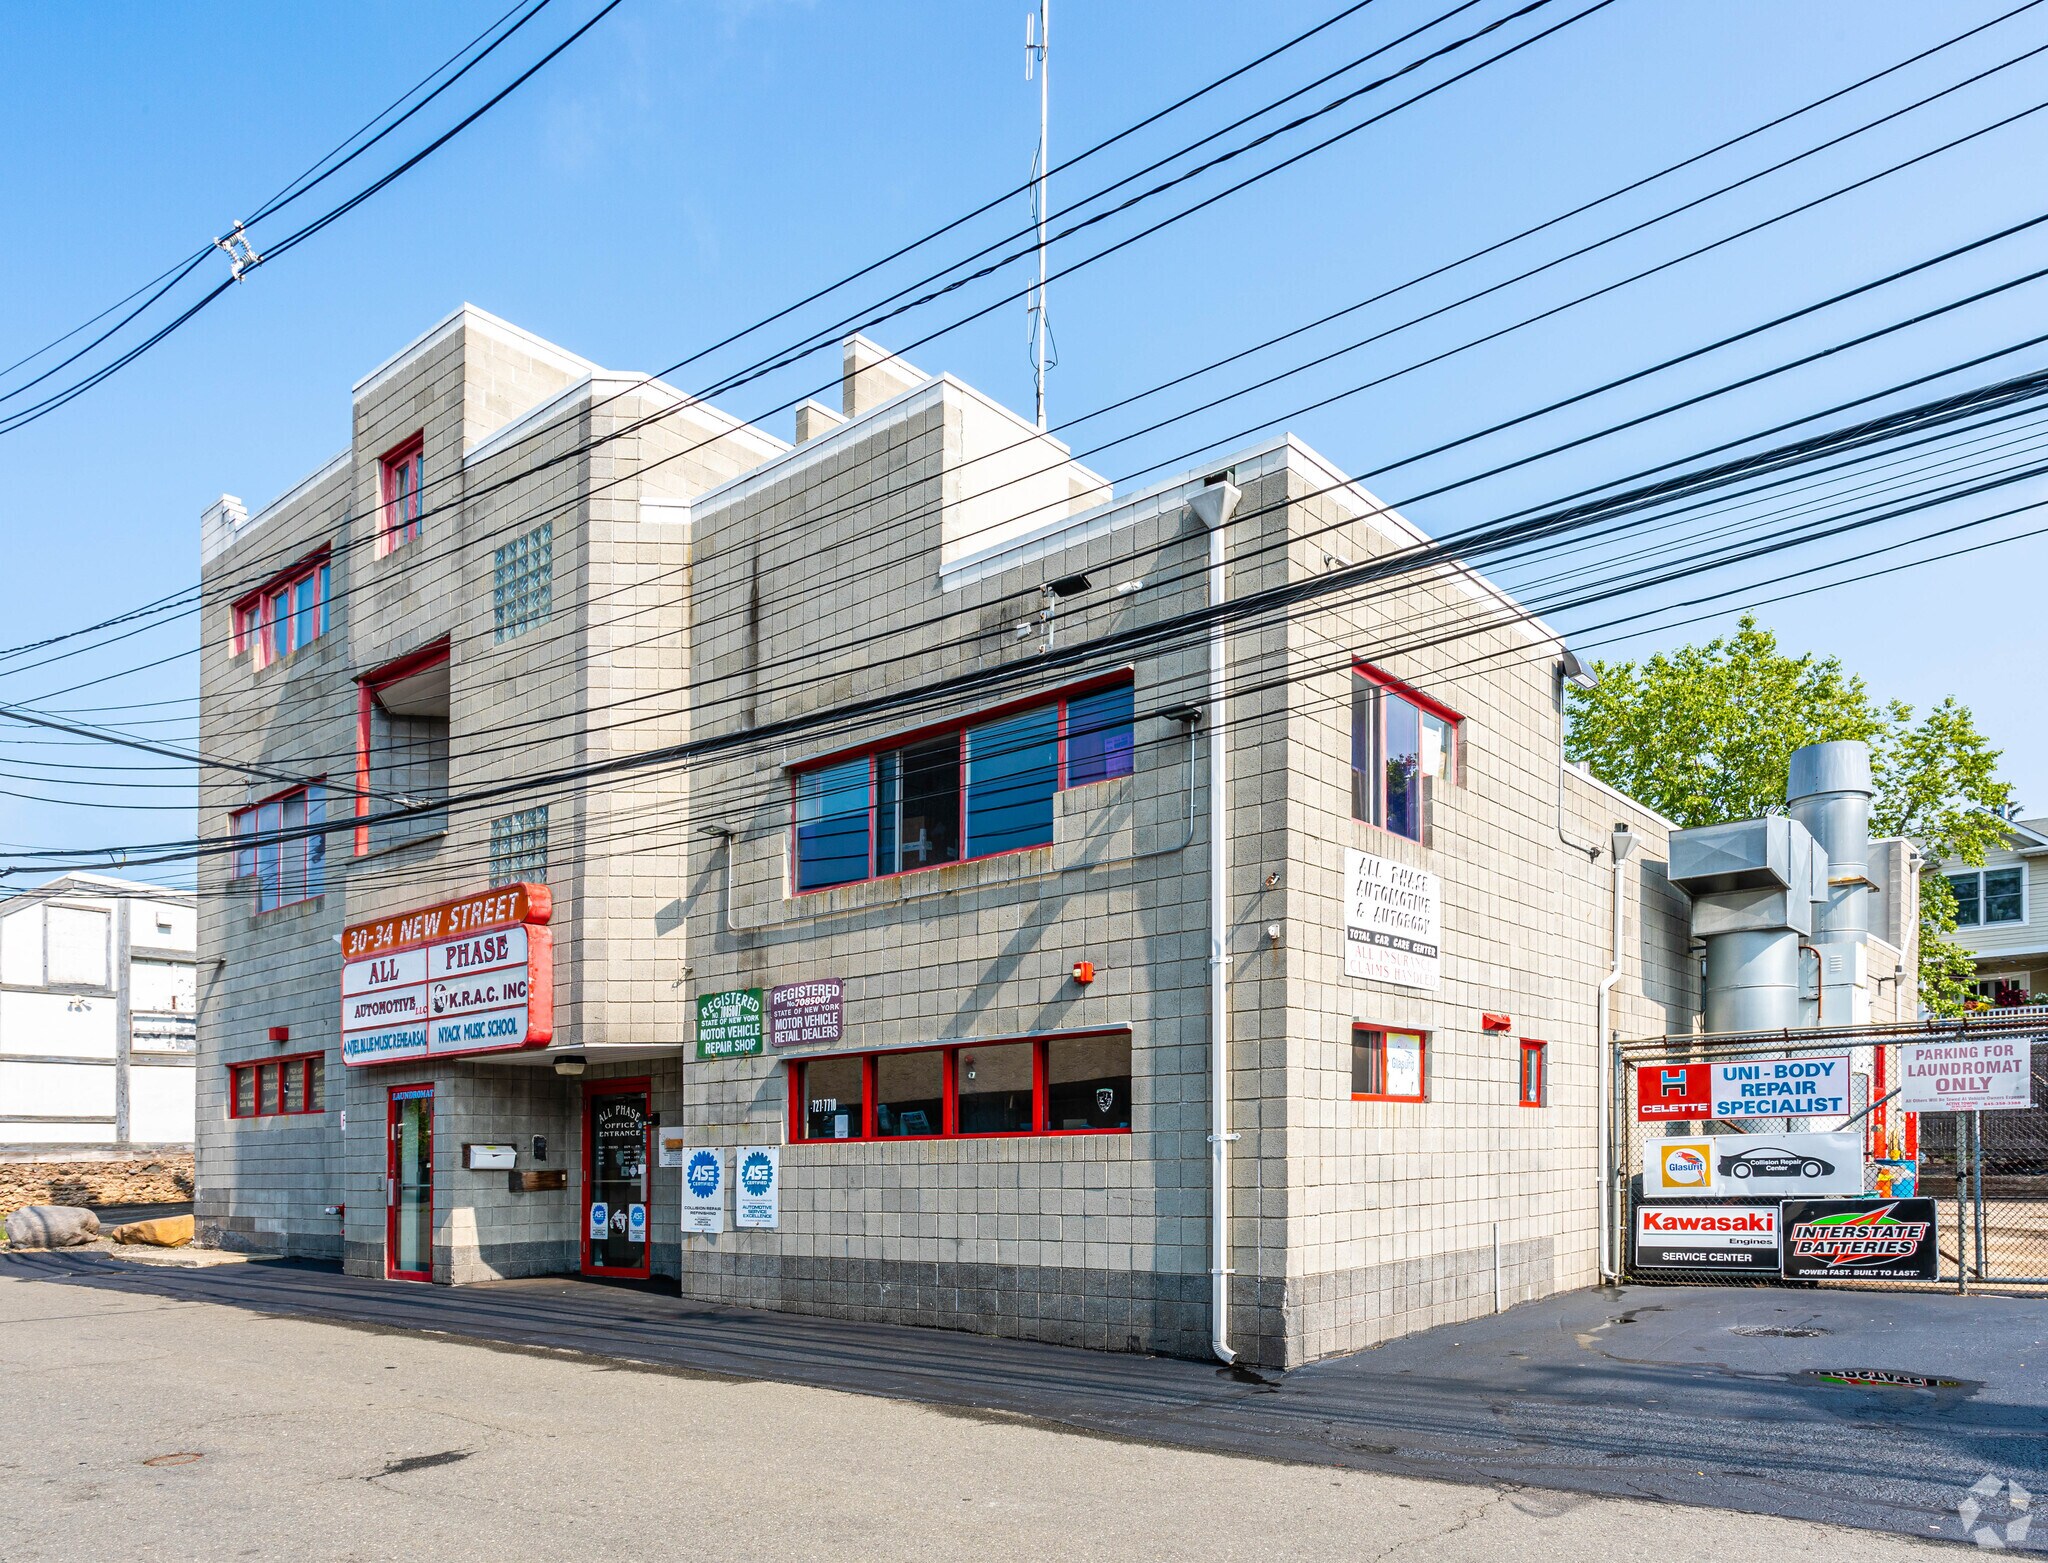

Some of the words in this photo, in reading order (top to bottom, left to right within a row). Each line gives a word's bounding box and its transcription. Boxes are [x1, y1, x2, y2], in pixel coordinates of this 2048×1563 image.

[349, 923, 394, 954] 30-34
[400, 911, 443, 943] NEW
[449, 892, 519, 932] STREET
[1349, 929, 1371, 942] TOTAL
[1374, 934, 1390, 946] CAR
[1393, 938, 1410, 951] CARE
[1412, 943, 1436, 957] CENTER
[368, 959, 400, 985] ALL
[446, 933, 509, 970] PHASE
[1355, 945, 1374, 960] ALL
[449, 988, 500, 1009] K.R.A.C.
[503, 980, 527, 1000] INC
[773, 984, 840, 1005] REGISTERED
[354, 995, 416, 1018] AUTOMOTIVE
[415, 1004, 428, 1016] LLC
[701, 992, 760, 1019] REGISTERED
[773, 1009, 792, 1017] STATE
[804, 1006, 819, 1014] NEW
[821, 1003, 840, 1011] YORK
[701, 1019, 719, 1027] STATE
[719, 1017, 727, 1025] OF
[775, 1016, 804, 1030] MOTOR
[804, 1012, 838, 1027] VEHICLE
[438, 1027, 461, 1043] NYACK
[463, 1022, 486, 1041] MUSIC
[487, 1017, 518, 1038] SCHOOL
[700, 1027, 726, 1041] MOTOR
[727, 1023, 761, 1038] VEHICLE
[774, 1029, 801, 1043] RETAIL
[802, 1026, 839, 1040] DEALERS
[705, 1041, 733, 1054] REPAIR
[734, 1038, 756, 1051] SHOP
[1915, 1046, 1979, 1060] PARKING
[1984, 1044, 2014, 1057] FOR
[1908, 1059, 2023, 1077] LAUNDROMAT
[1741, 1080, 1816, 1098] REPAIR
[1935, 1076, 1993, 1092] ONLY
[392, 1089, 434, 1101] LAUNDROMAT
[599, 1107, 612, 1124] ALL
[615, 1104, 641, 1123] PHASE
[1641, 1103, 1708, 1114] CELETTE
[1717, 1097, 1843, 1115] SPECIALIST
[604, 1121, 636, 1129] OFFICE
[1669, 1162, 1704, 1172] Glasurit
[1750, 1158, 1780, 1166] Collision
[1780, 1158, 1802, 1167] Repair
[691, 1165, 715, 1181] ASE
[745, 1164, 769, 1181] ASE
[1643, 1212, 1773, 1232] Kawasaki
[1794, 1224, 1924, 1240] INTERSTATE
[1729, 1238, 1773, 1246] Engines
[1793, 1240, 1915, 1256] BATTERIES
[1662, 1252, 1707, 1261] SERVICE
[1708, 1253, 1753, 1263] CENTER
